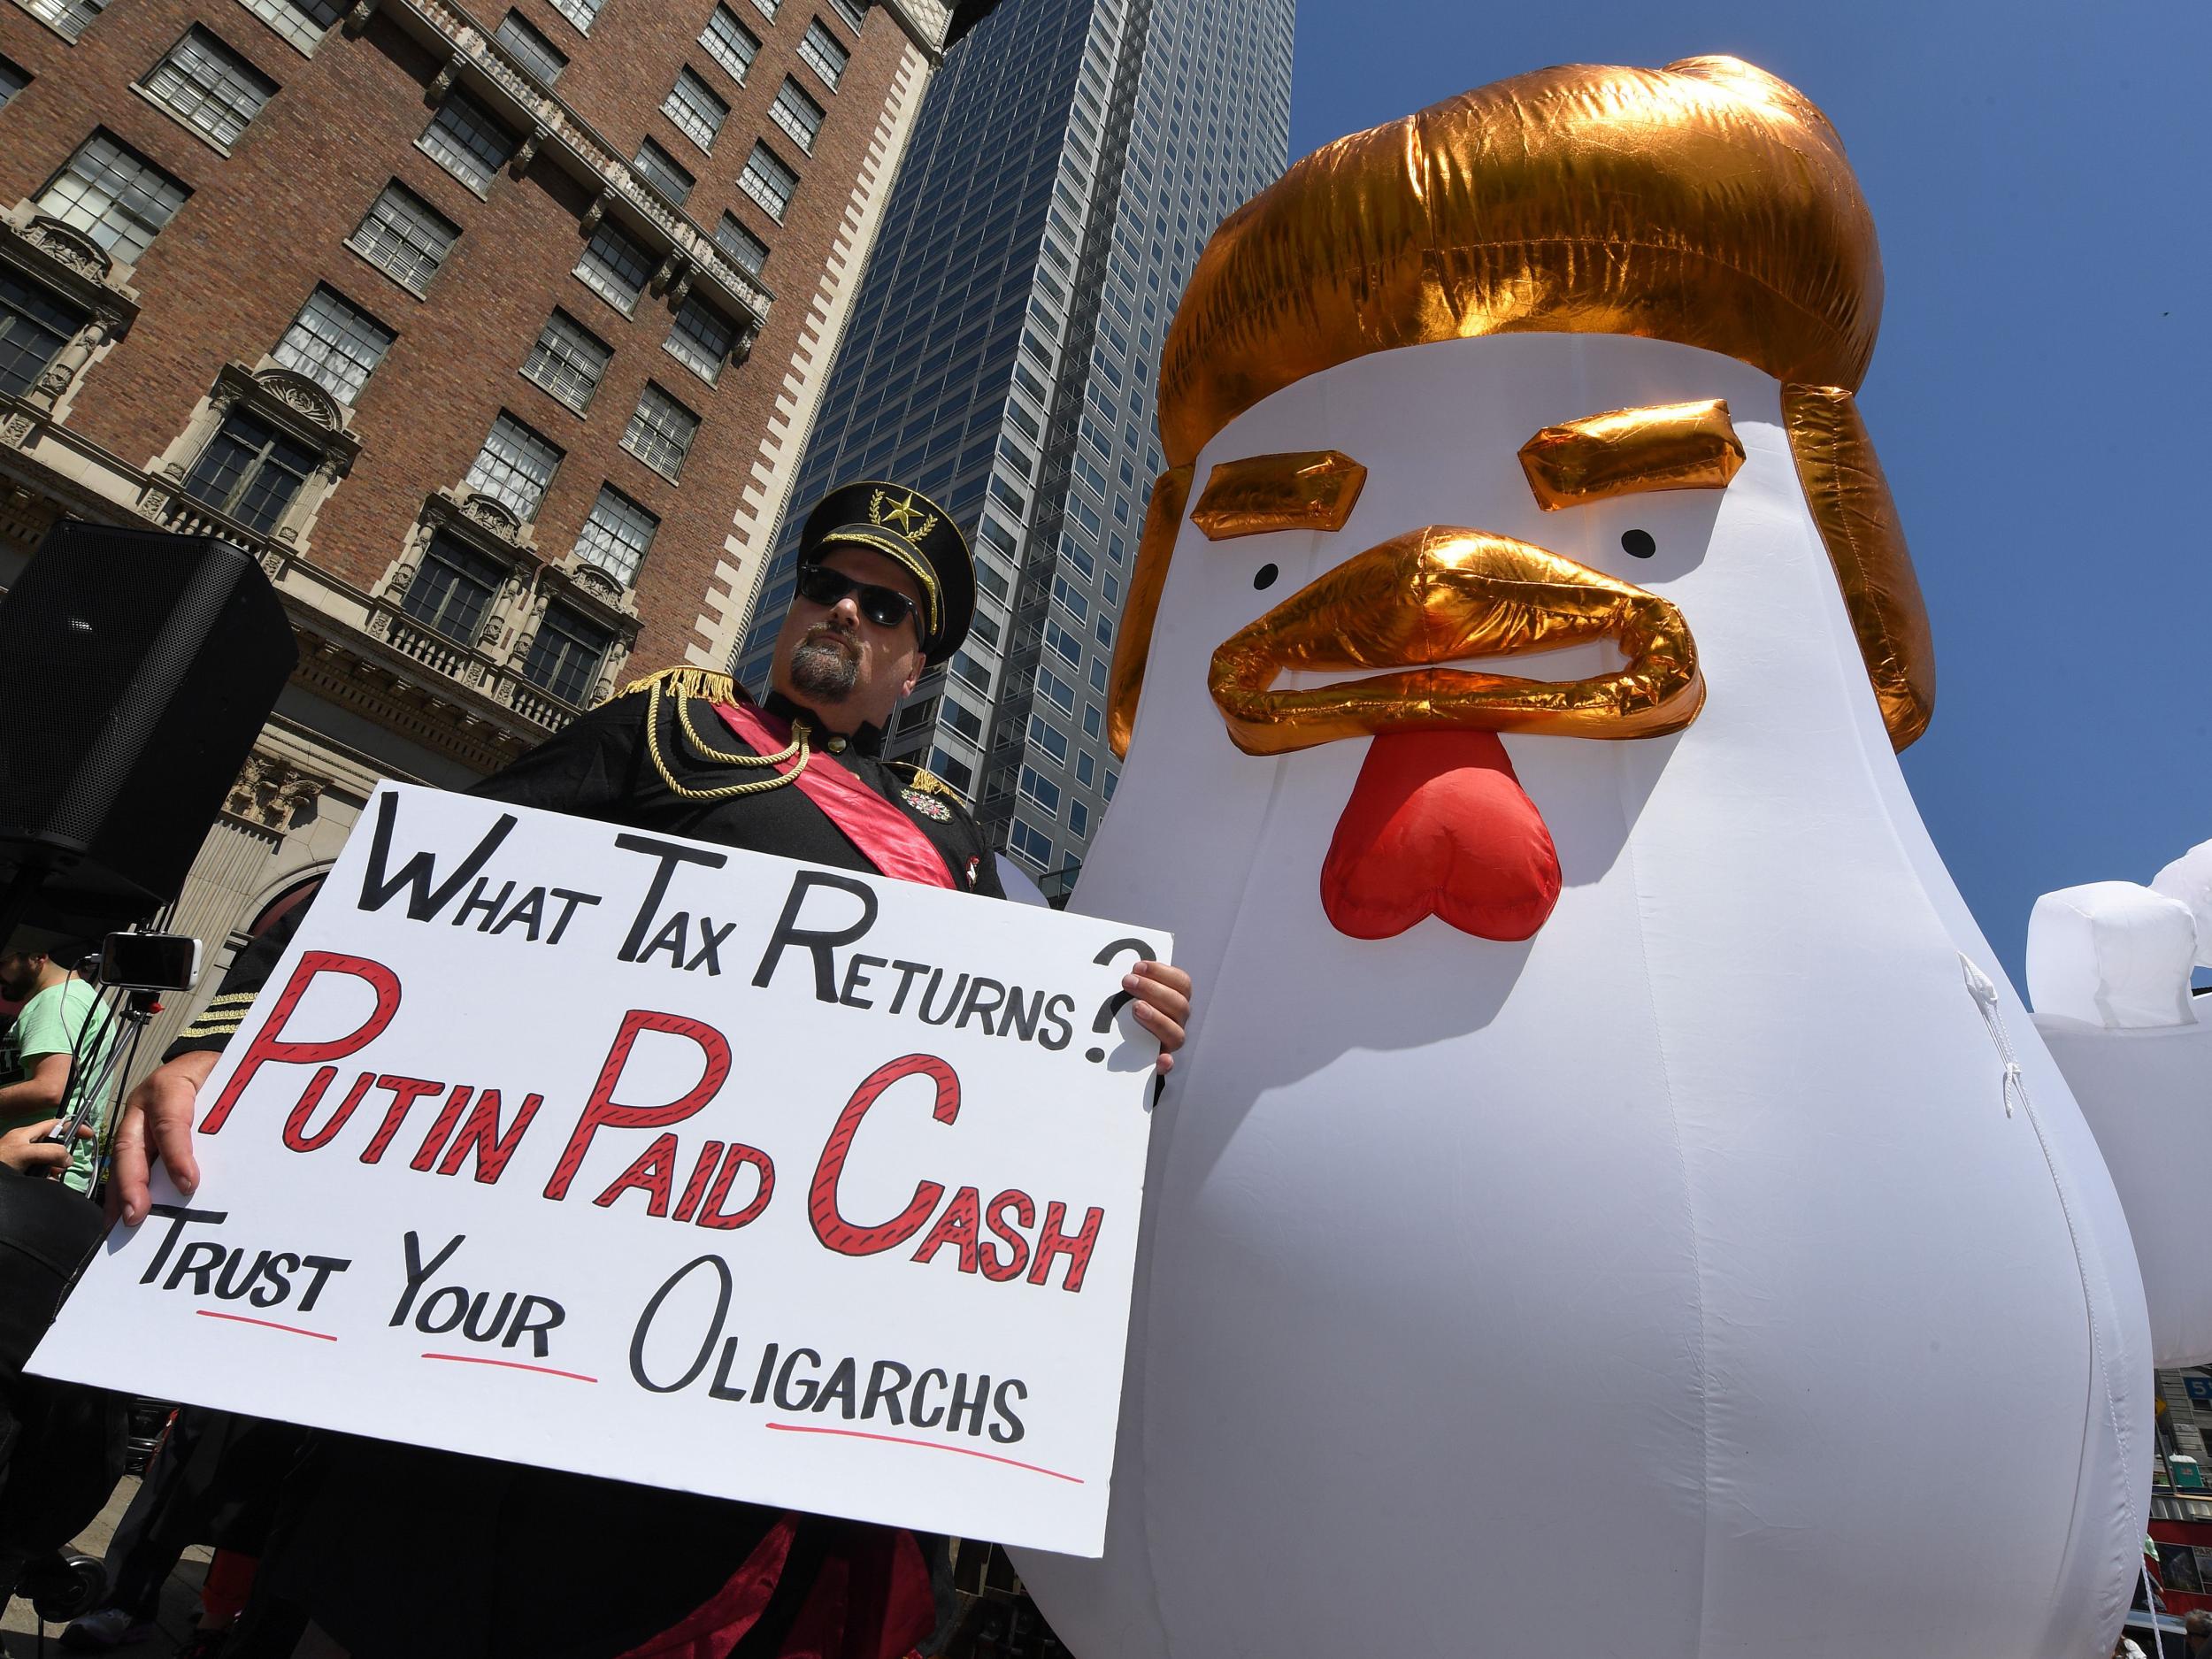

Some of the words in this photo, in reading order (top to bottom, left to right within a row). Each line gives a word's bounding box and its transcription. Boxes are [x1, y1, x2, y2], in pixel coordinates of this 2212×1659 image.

[357, 792, 602, 944] WHAT
[615, 833, 736, 976] TAX
[198, 950, 544, 1185] PUTIN
[542, 1010, 775, 1230] PAID
[808, 1054, 1104, 1293] CASH
[139, 1204, 352, 1311] TRUST
[388, 1231, 565, 1357] YOUR
[630, 1255, 1027, 1443] OLIGARCHS
